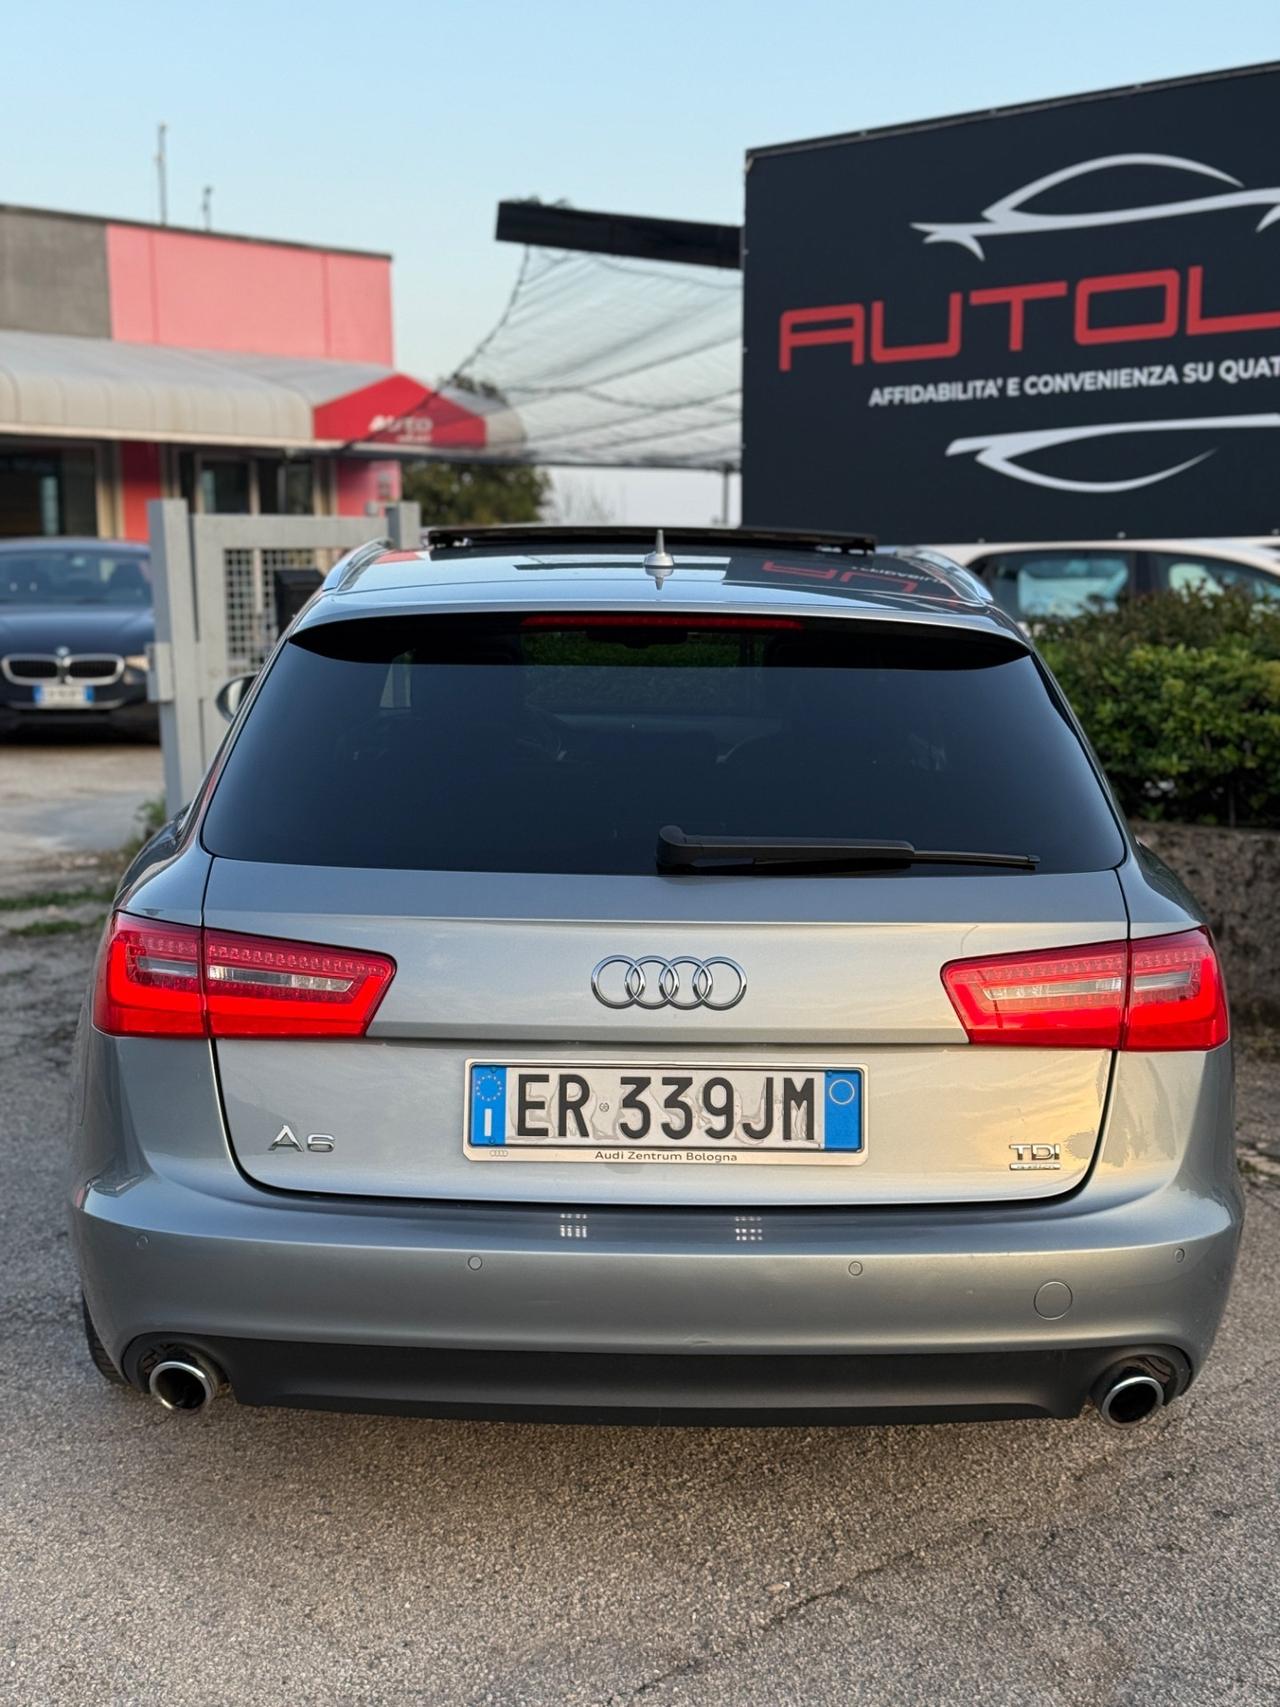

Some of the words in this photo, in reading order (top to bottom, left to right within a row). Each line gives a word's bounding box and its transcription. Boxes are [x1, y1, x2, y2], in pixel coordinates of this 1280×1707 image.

[779, 265, 1280, 372] AUTOL
[868, 378, 1003, 407] AFFIDABILITA'
[1006, 376, 1021, 397] E
[1023, 363, 1179, 396] CONVENIENZA
[1182, 361, 1214, 384] SU
[517, 1073, 591, 1138] ER
[268, 1124, 335, 1153] A6
[1009, 1143, 1061, 1161] TDI
[595, 1151, 624, 1160] Audi
[627, 1151, 682, 1161] Zentrum
[686, 1152, 738, 1164] Bologna
